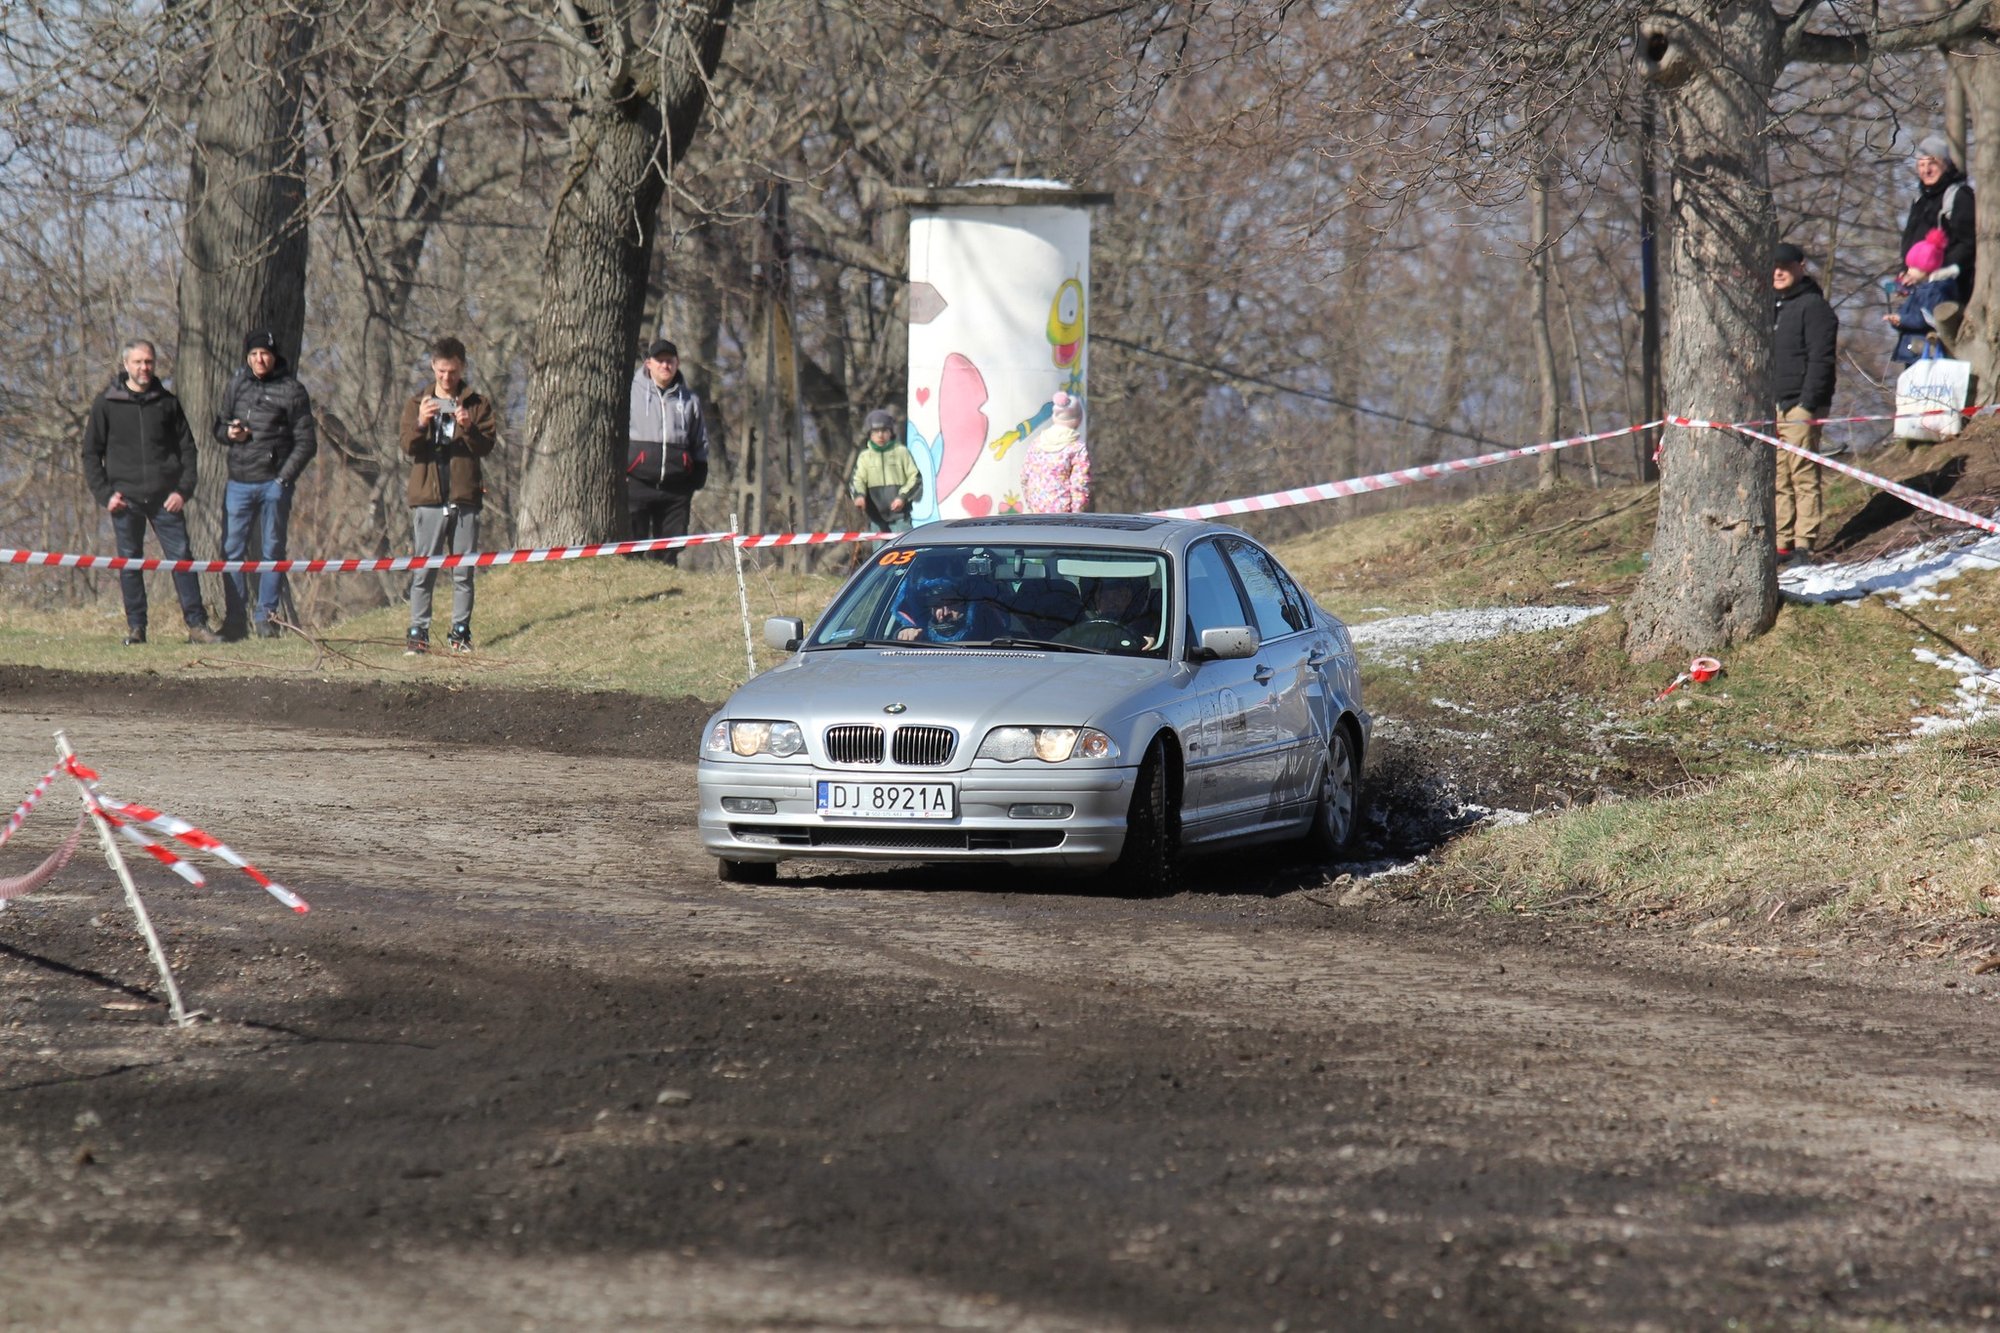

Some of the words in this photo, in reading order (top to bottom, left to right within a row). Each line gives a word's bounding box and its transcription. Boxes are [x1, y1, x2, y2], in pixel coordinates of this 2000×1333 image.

[878, 550, 916, 566] 03
[833, 785, 860, 809] DJ
[872, 786, 946, 810] 8921A
